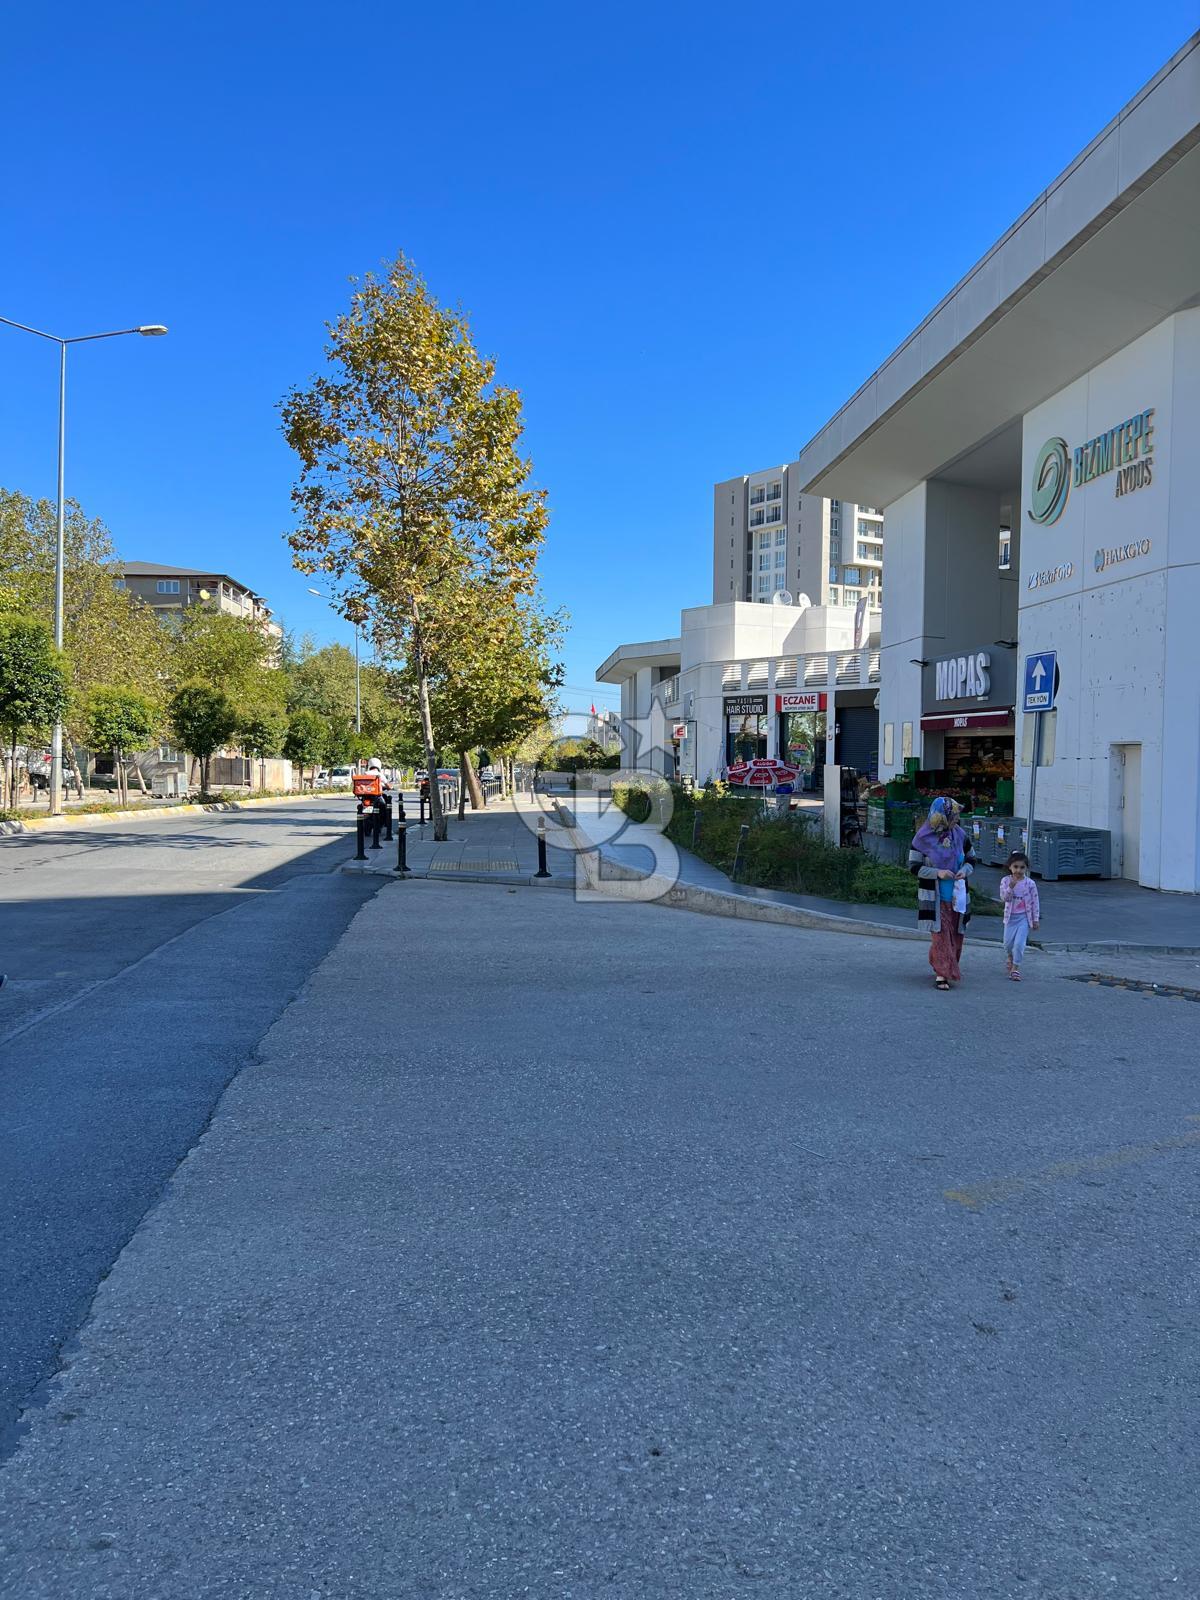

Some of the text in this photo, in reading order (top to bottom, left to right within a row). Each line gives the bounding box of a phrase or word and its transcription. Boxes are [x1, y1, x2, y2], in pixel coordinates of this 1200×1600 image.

[1115, 457, 1153, 498] AYDOS
[783, 695, 816, 706] ECZANE
[1028, 696, 1036, 704] TEK
[726, 704, 764, 714] HAIR STUDIO
[676, 727, 684, 736] E
